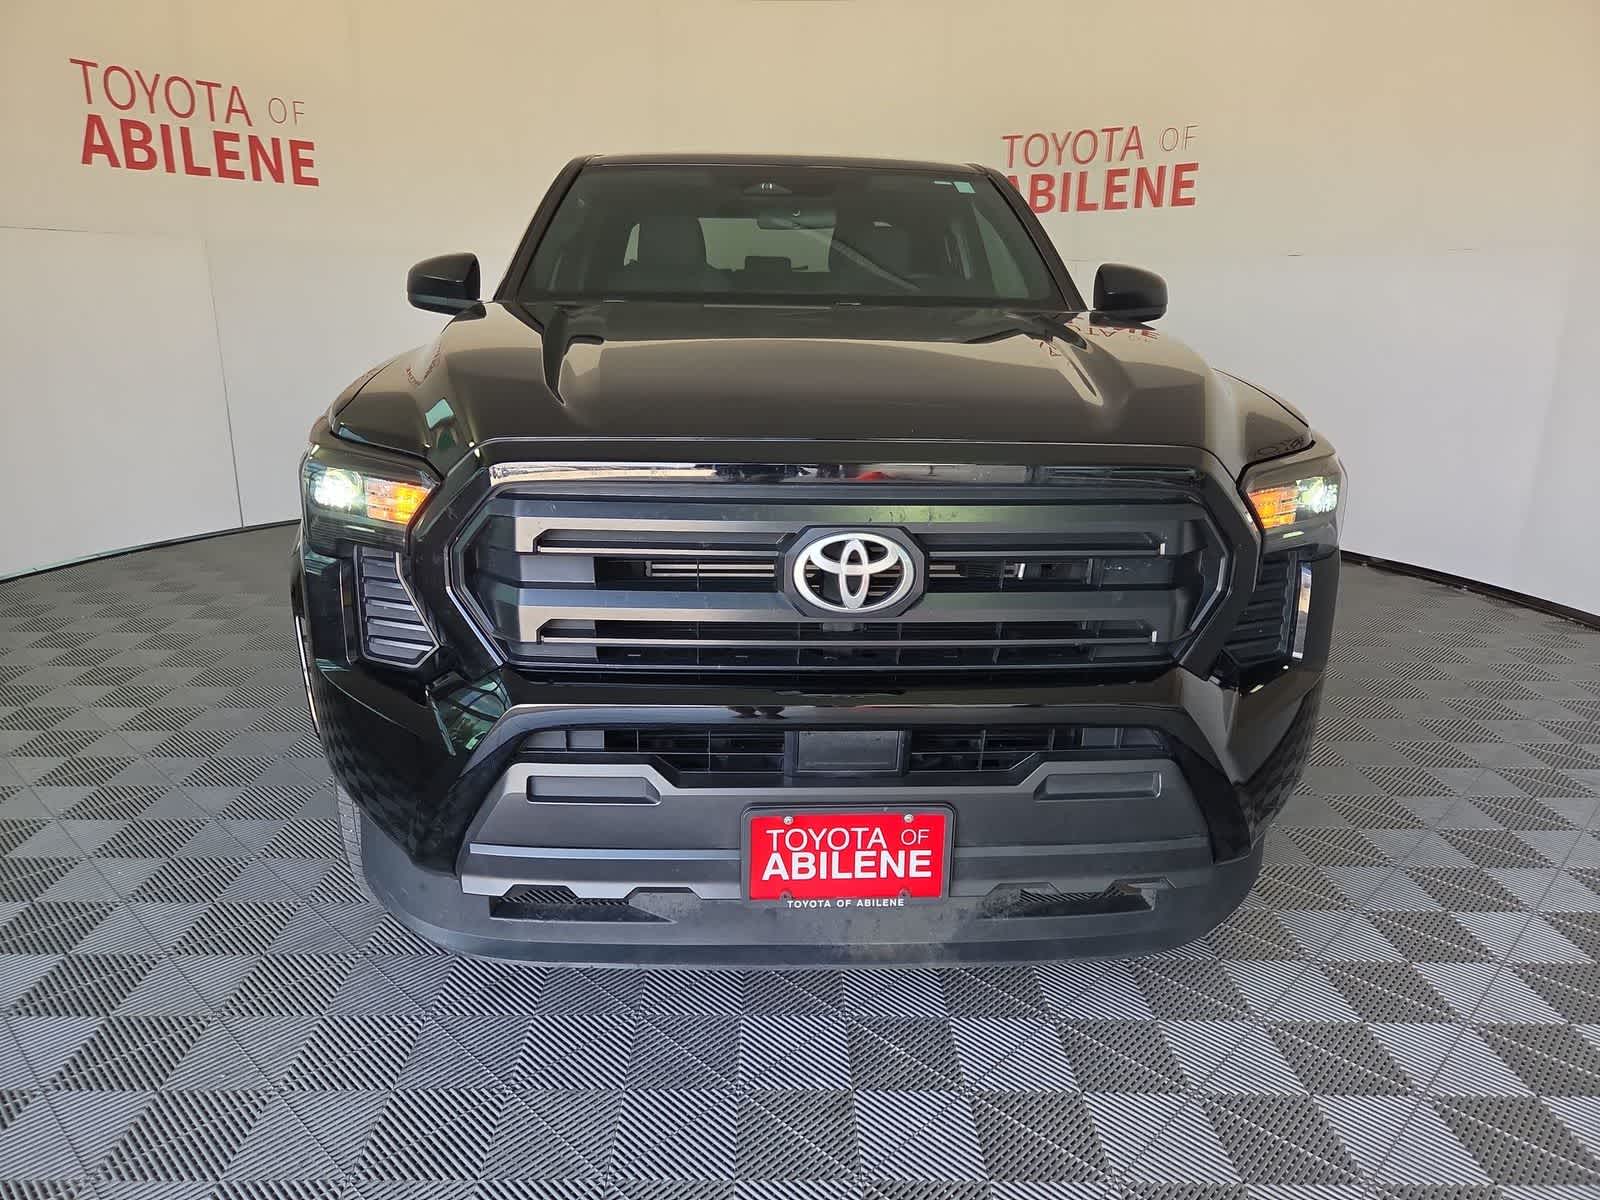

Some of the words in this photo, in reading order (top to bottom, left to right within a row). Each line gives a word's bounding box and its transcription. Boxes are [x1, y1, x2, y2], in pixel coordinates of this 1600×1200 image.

[69, 58, 252, 127] TOYOTA
[268, 97, 305, 125] OF
[81, 113, 319, 187] ABILENE
[1002, 125, 1144, 168] TOYOTA
[1161, 125, 1198, 151] OF
[766, 828, 887, 851] TOYOTA
[901, 829, 929, 845] OF
[762, 850, 932, 880] ABILENE
[787, 900, 831, 908] TOYOTA
[836, 899, 851, 908] OF
[857, 899, 905, 907] ABILENE
